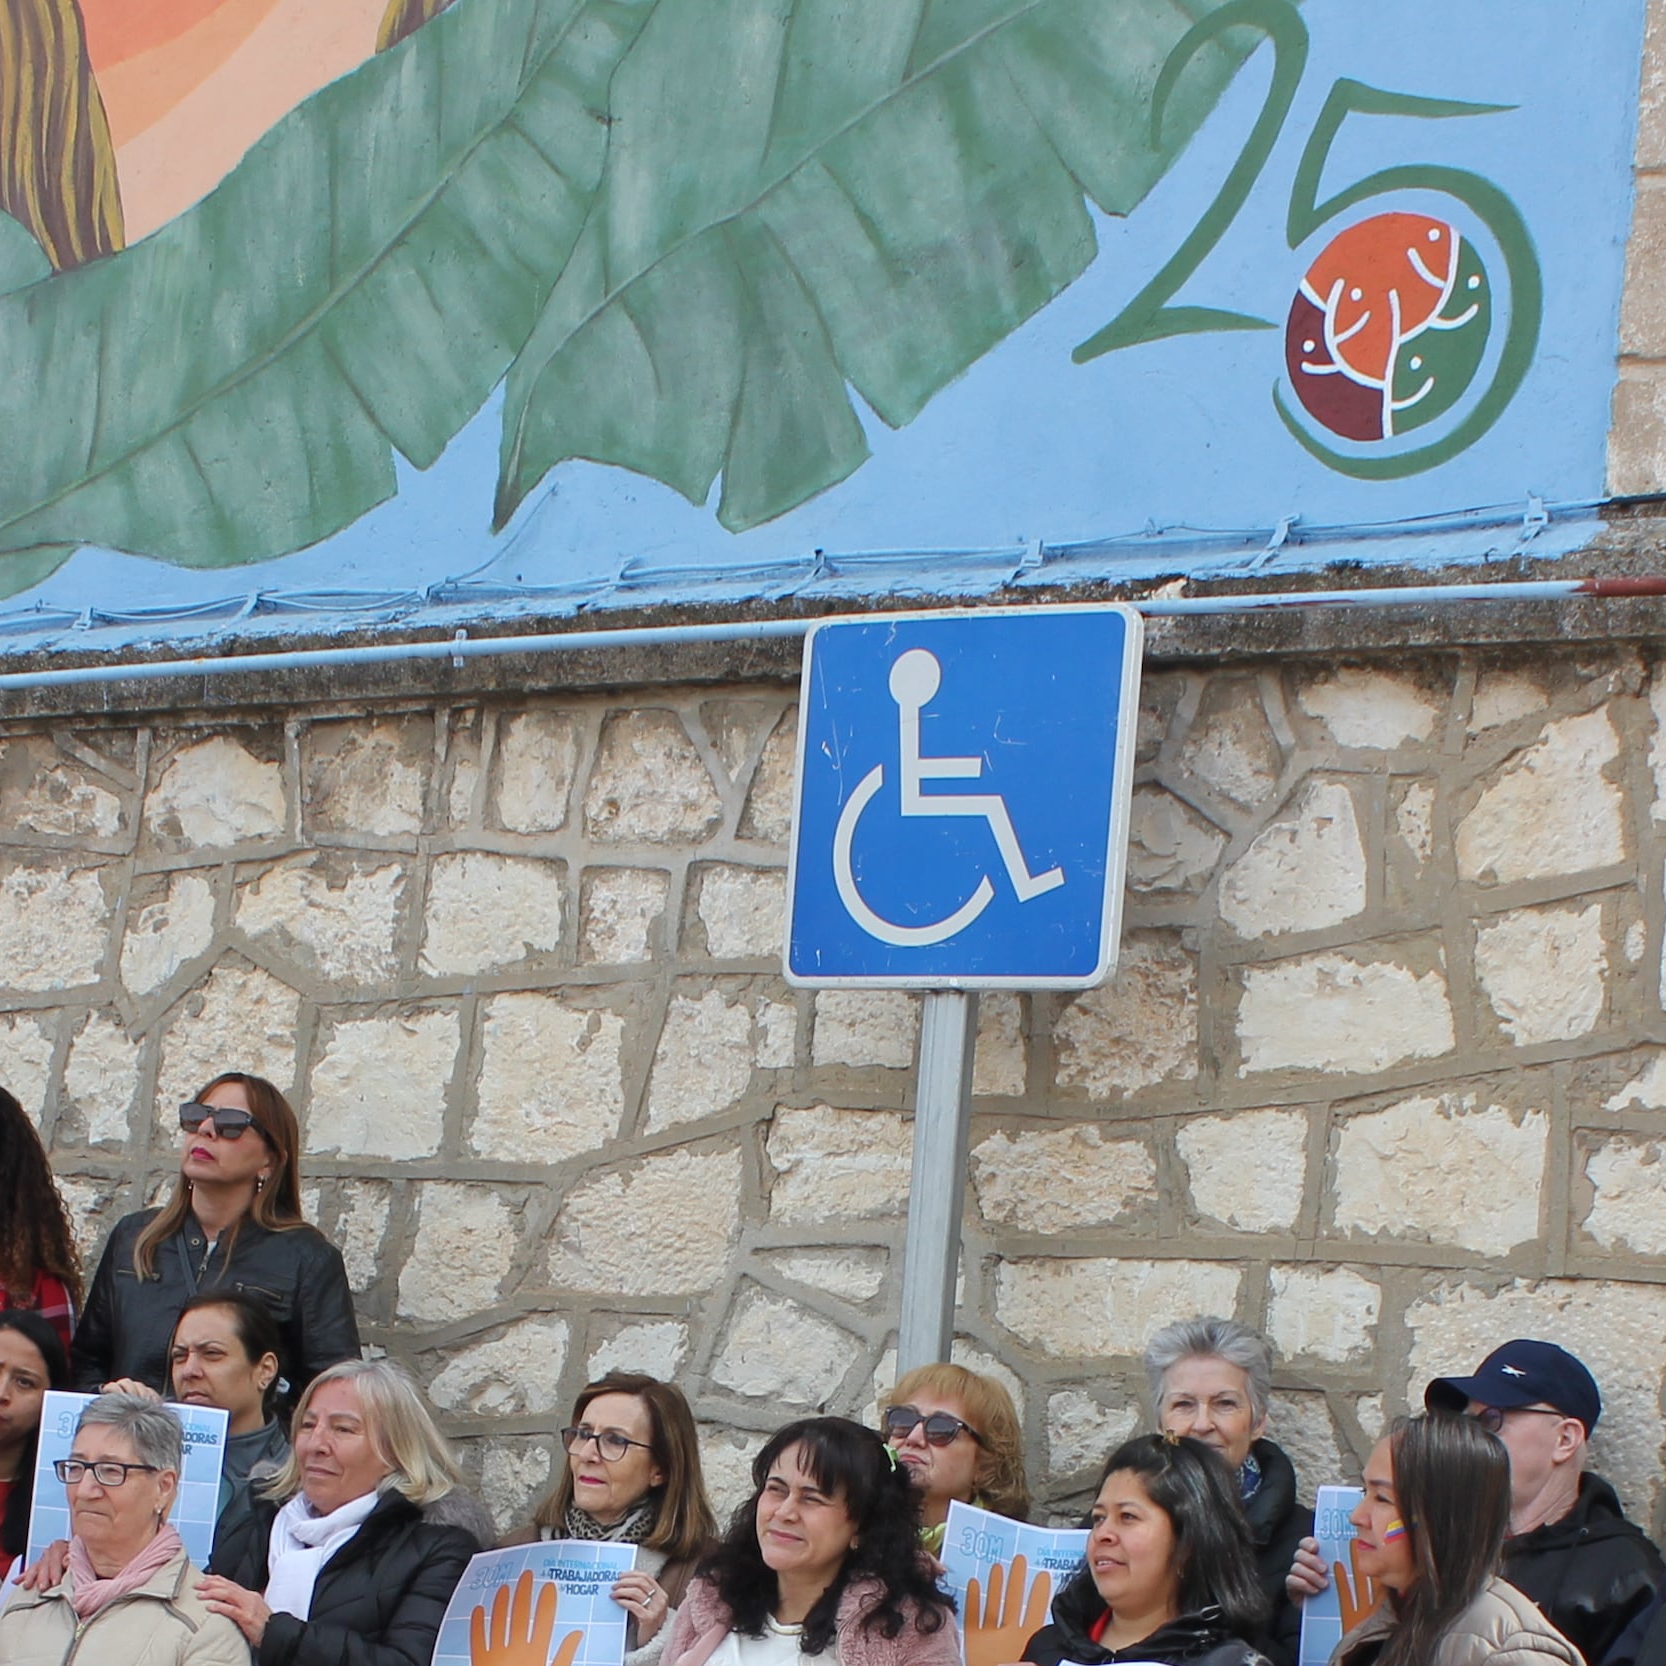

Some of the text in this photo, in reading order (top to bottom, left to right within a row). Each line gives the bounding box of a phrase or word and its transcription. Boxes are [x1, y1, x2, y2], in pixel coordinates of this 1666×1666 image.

[1070, 0, 1542, 481] 25
[959, 1525, 1005, 1564] 30M
[549, 1568, 623, 1583] TRABAJADORAS
[566, 1583, 599, 1596] HOGAR
